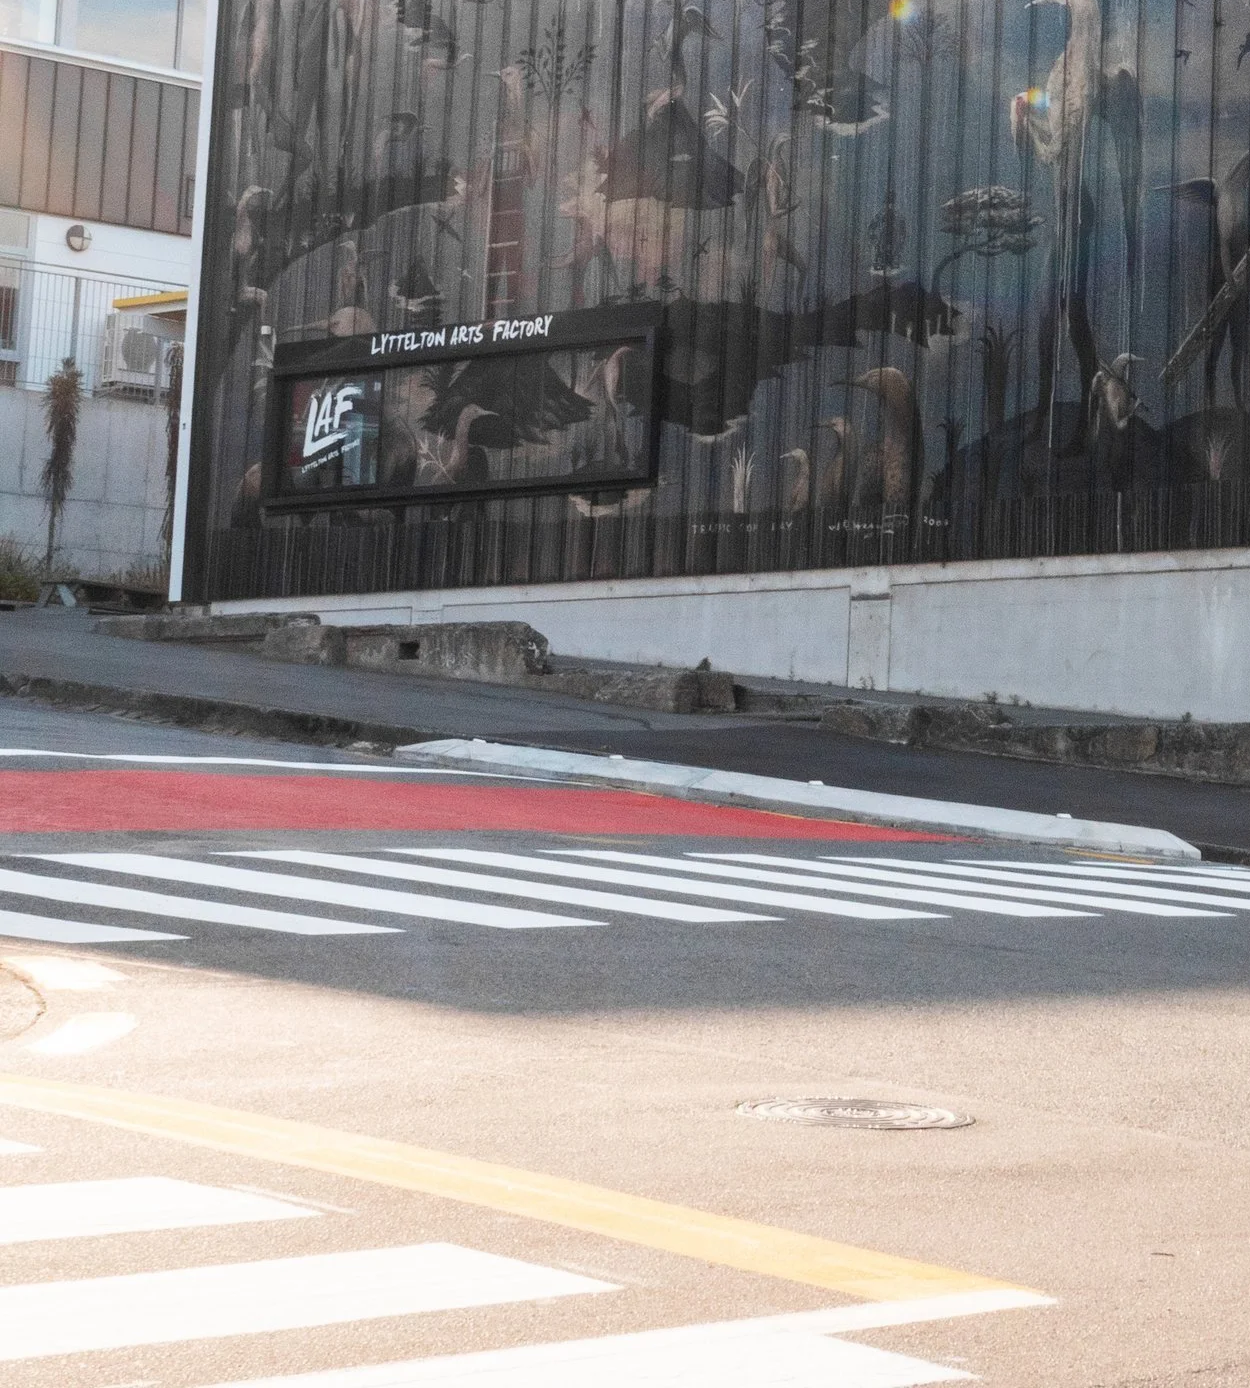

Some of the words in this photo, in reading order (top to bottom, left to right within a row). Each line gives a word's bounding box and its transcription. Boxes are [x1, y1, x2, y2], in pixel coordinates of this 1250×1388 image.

[370, 327, 446, 355] LYTTELTON
[450, 324, 484, 346] ARTS
[492, 315, 554, 342] FACTORY
[303, 386, 363, 458] LAF
